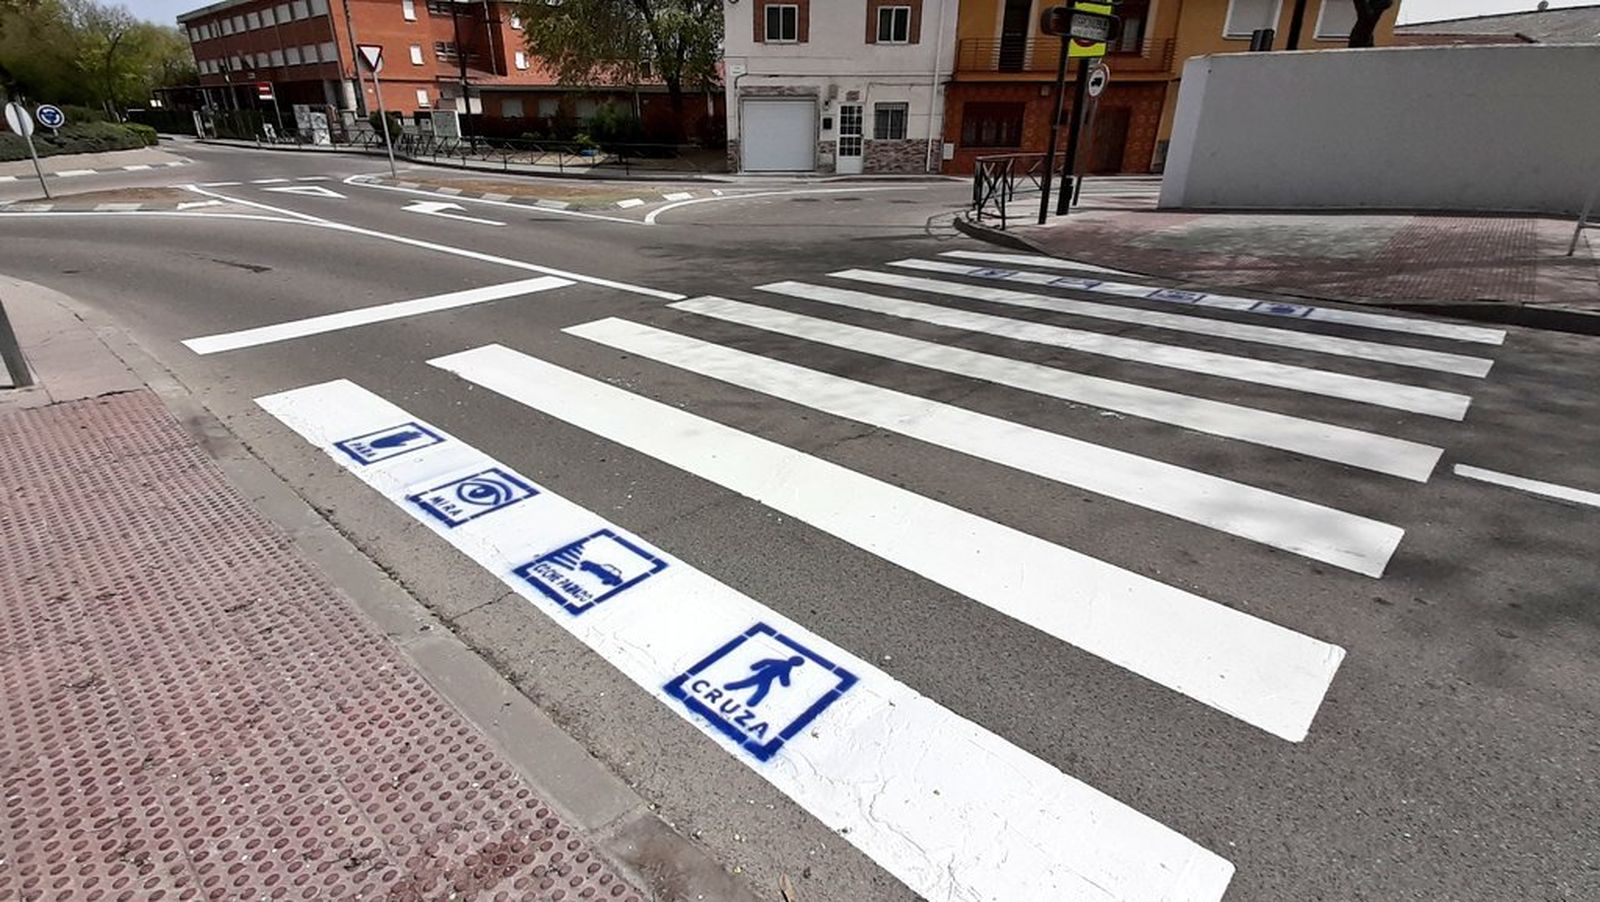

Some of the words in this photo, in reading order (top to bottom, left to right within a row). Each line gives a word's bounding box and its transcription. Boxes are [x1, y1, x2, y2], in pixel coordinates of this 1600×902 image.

[428, 495, 464, 517] MIRA
[533, 563, 564, 582] COCHE
[691, 679, 769, 740] CRUZA
